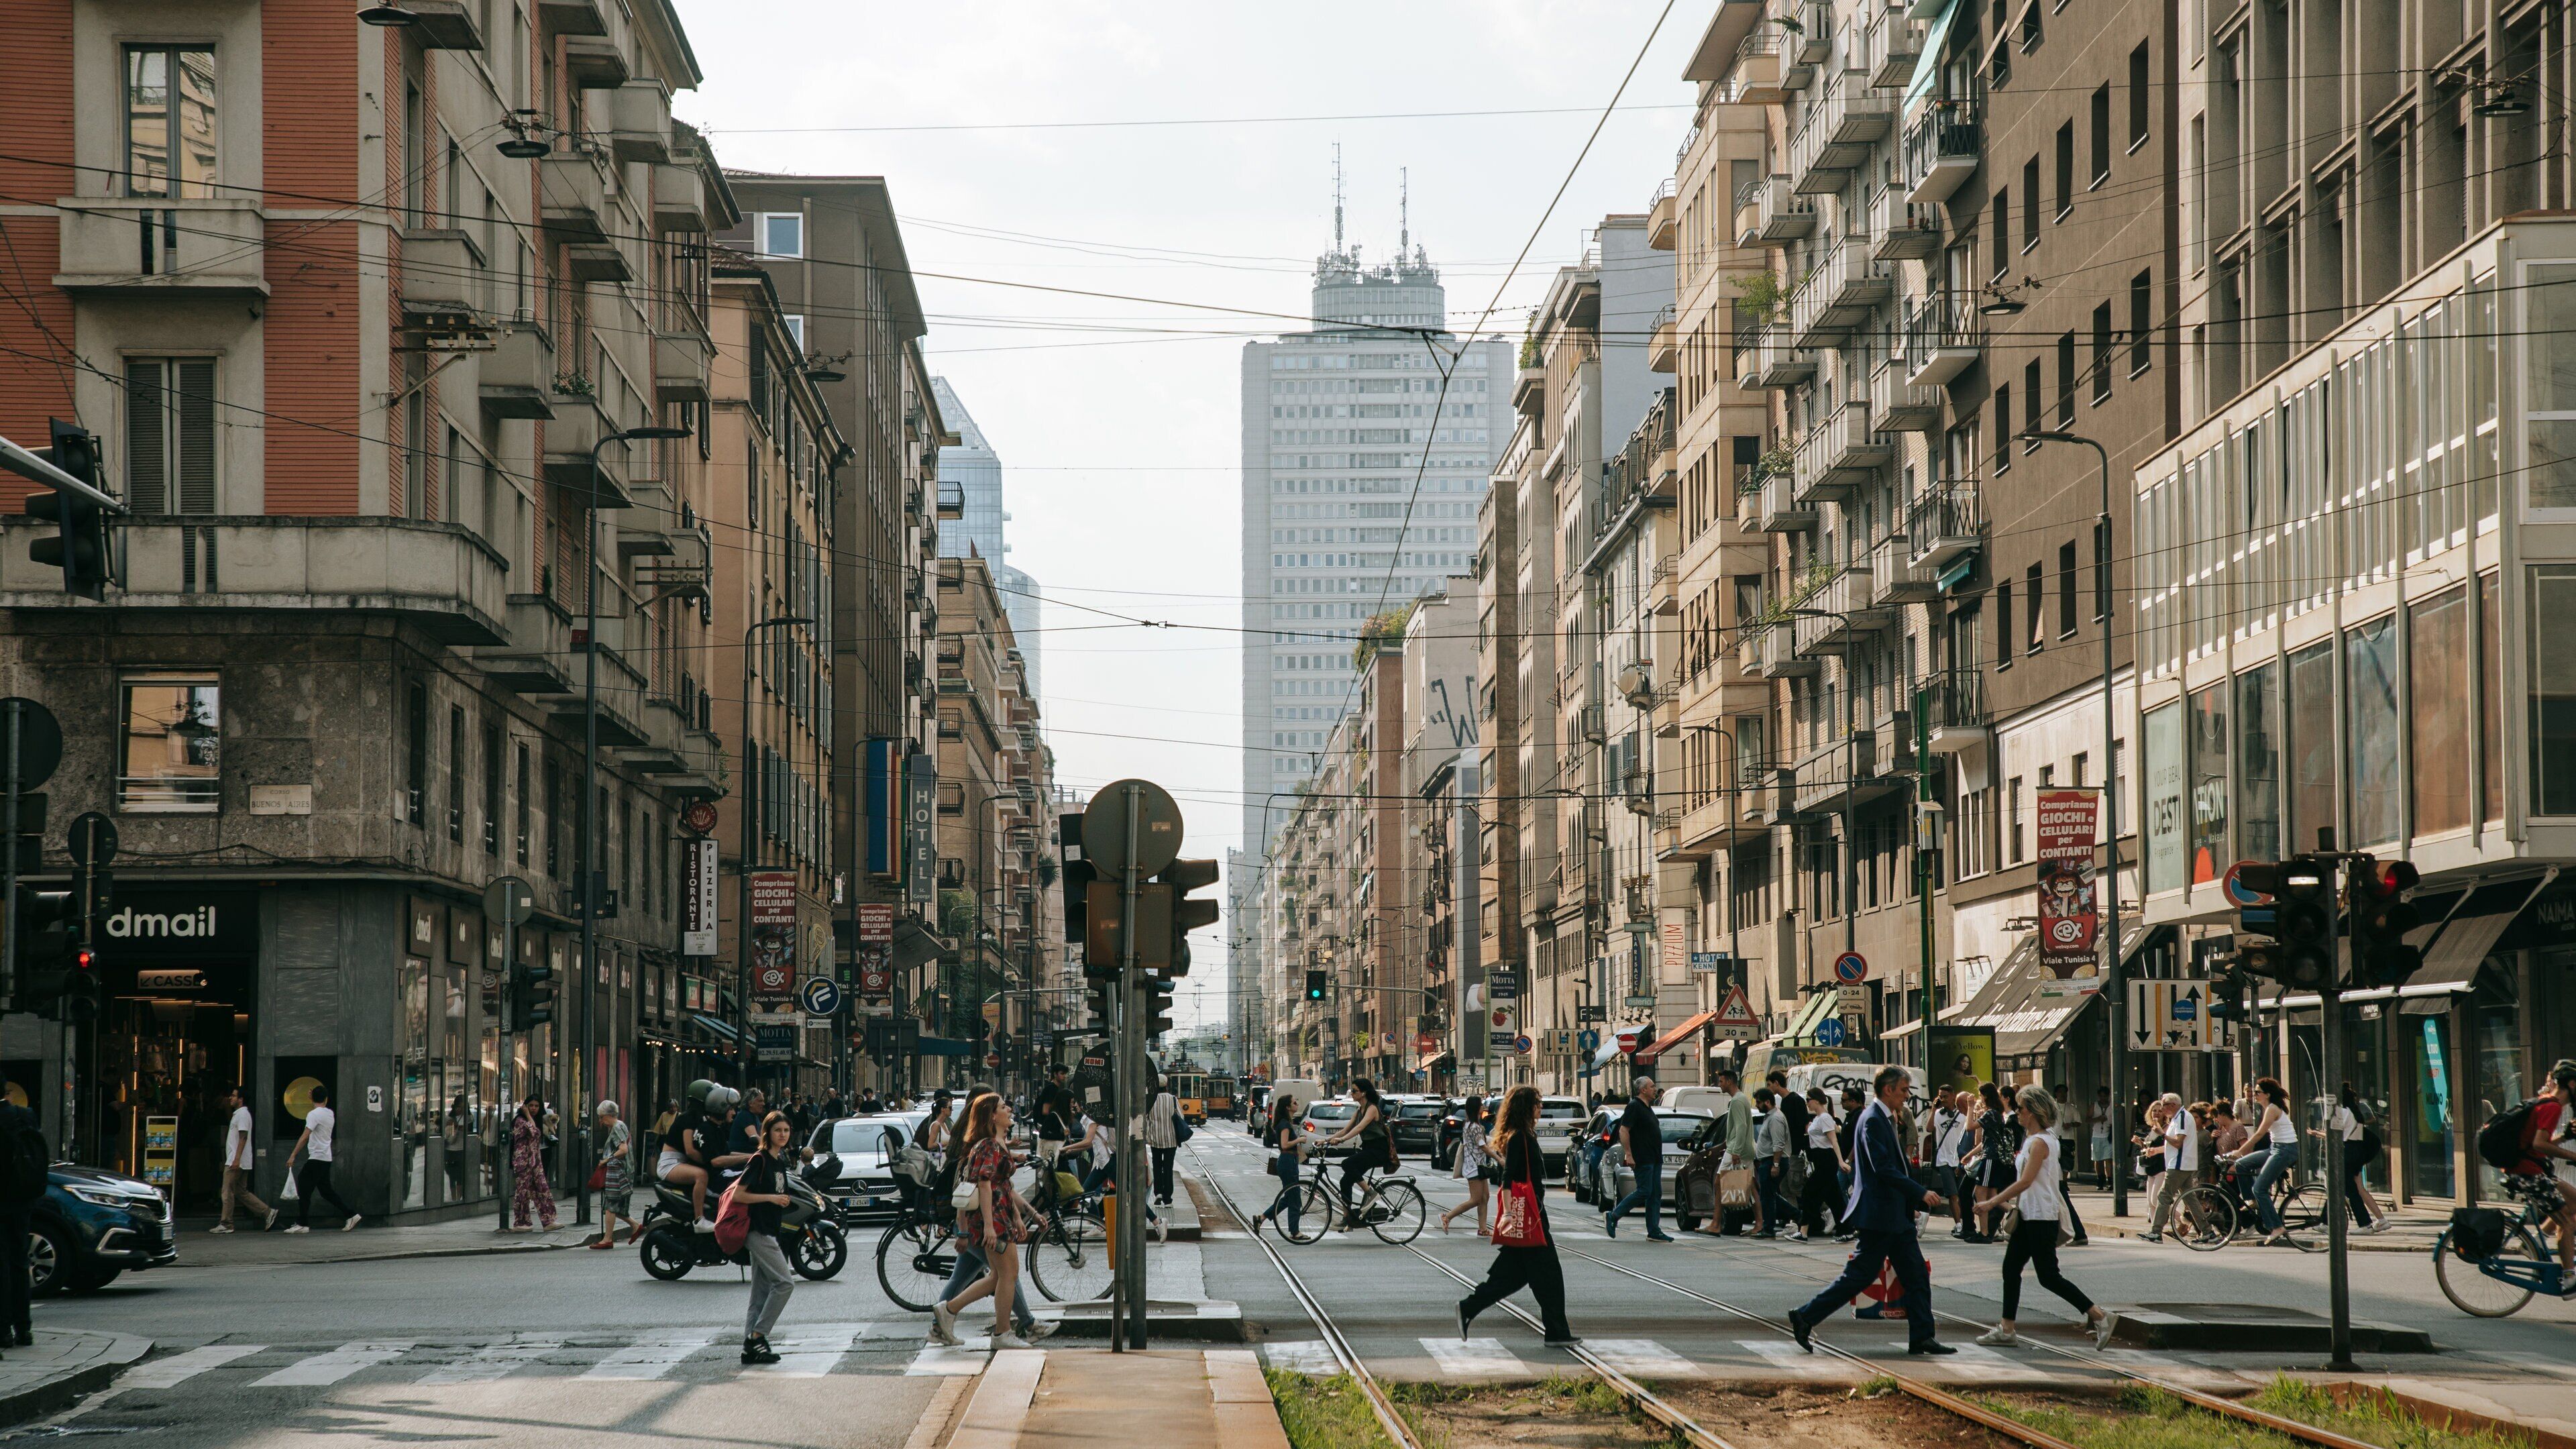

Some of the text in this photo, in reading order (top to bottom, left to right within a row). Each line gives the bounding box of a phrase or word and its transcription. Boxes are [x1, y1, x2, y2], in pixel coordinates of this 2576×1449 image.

[251, 800, 311, 808] BUENOS AIRES
[2040, 801, 2096, 810] Compriamo
[2041, 812, 2086, 824] GIOCHI
[915, 790, 929, 879] HOTEL
[2039, 825, 2094, 837] CELLULARI
[2057, 837, 2074, 846] per
[2039, 846, 2092, 859] CONTANTI
[688, 843, 697, 931] RISTORANTE
[705, 843, 714, 930] PIZZERIA
[754, 889, 790, 898] GIOCHI
[105, 906, 216, 937] dmail
[1664, 924, 1684, 965] PIZZIUM
[2043, 954, 2096, 965] Viale Tunisia 4
[1627, 998, 1652, 1006] osteria
[1517, 1196, 1526, 1228] DESIGN
